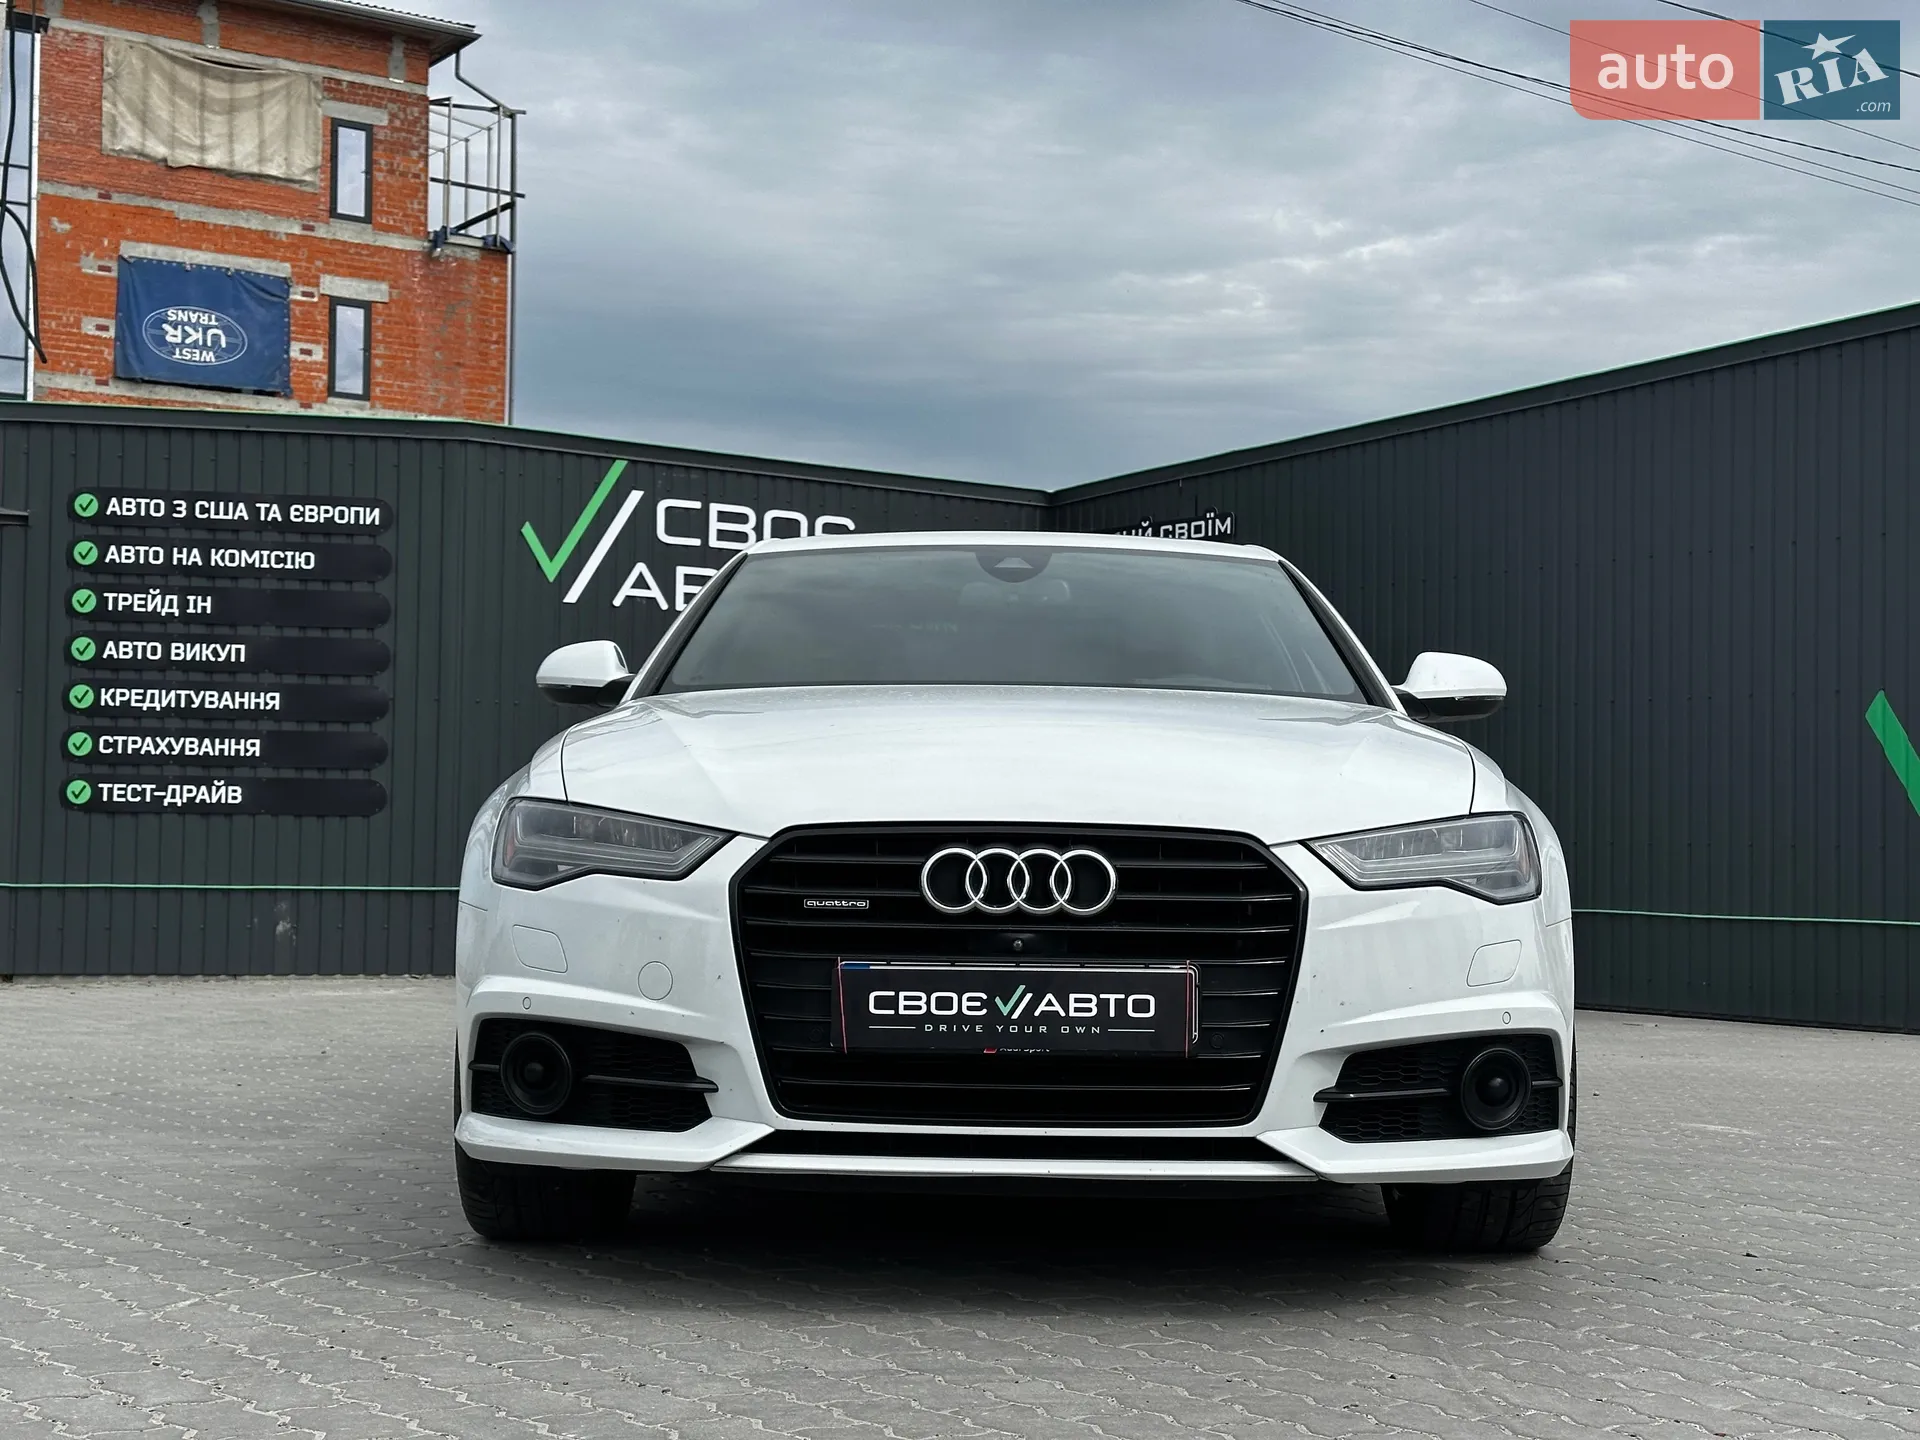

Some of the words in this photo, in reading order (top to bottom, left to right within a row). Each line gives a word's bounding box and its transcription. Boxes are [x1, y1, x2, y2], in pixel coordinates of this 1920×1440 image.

[167, 309, 219, 326] TRANS
[162, 323, 227, 348] UKR
[172, 347, 216, 362] WEST
[105, 497, 165, 518] АВТО
[172, 500, 187, 518] З
[194, 500, 249, 521] США
[255, 502, 283, 522] ТА
[289, 504, 380, 526] ЄВРОПИ
[104, 544, 164, 565] АВТО
[172, 547, 203, 567] НА
[210, 548, 315, 570] КОМІСІЮ
[103, 588, 180, 617] ТРЕЙД
[186, 595, 212, 614] ІН
[102, 640, 162, 661] АВТО
[170, 643, 246, 663] ВИКУП
[100, 687, 281, 712] КРЕДИТУВАННЯ
[98, 735, 261, 757] СТРАХУВАННЯ
[97, 779, 243, 807] ТЕСТ-ДРАЙВ
[1033, 992, 1156, 1018] АВТО
[924, 1024, 984, 1033] DRIVE
[995, 1024, 1048, 1034] YOUR
[1060, 1025, 1101, 1034] OWN
